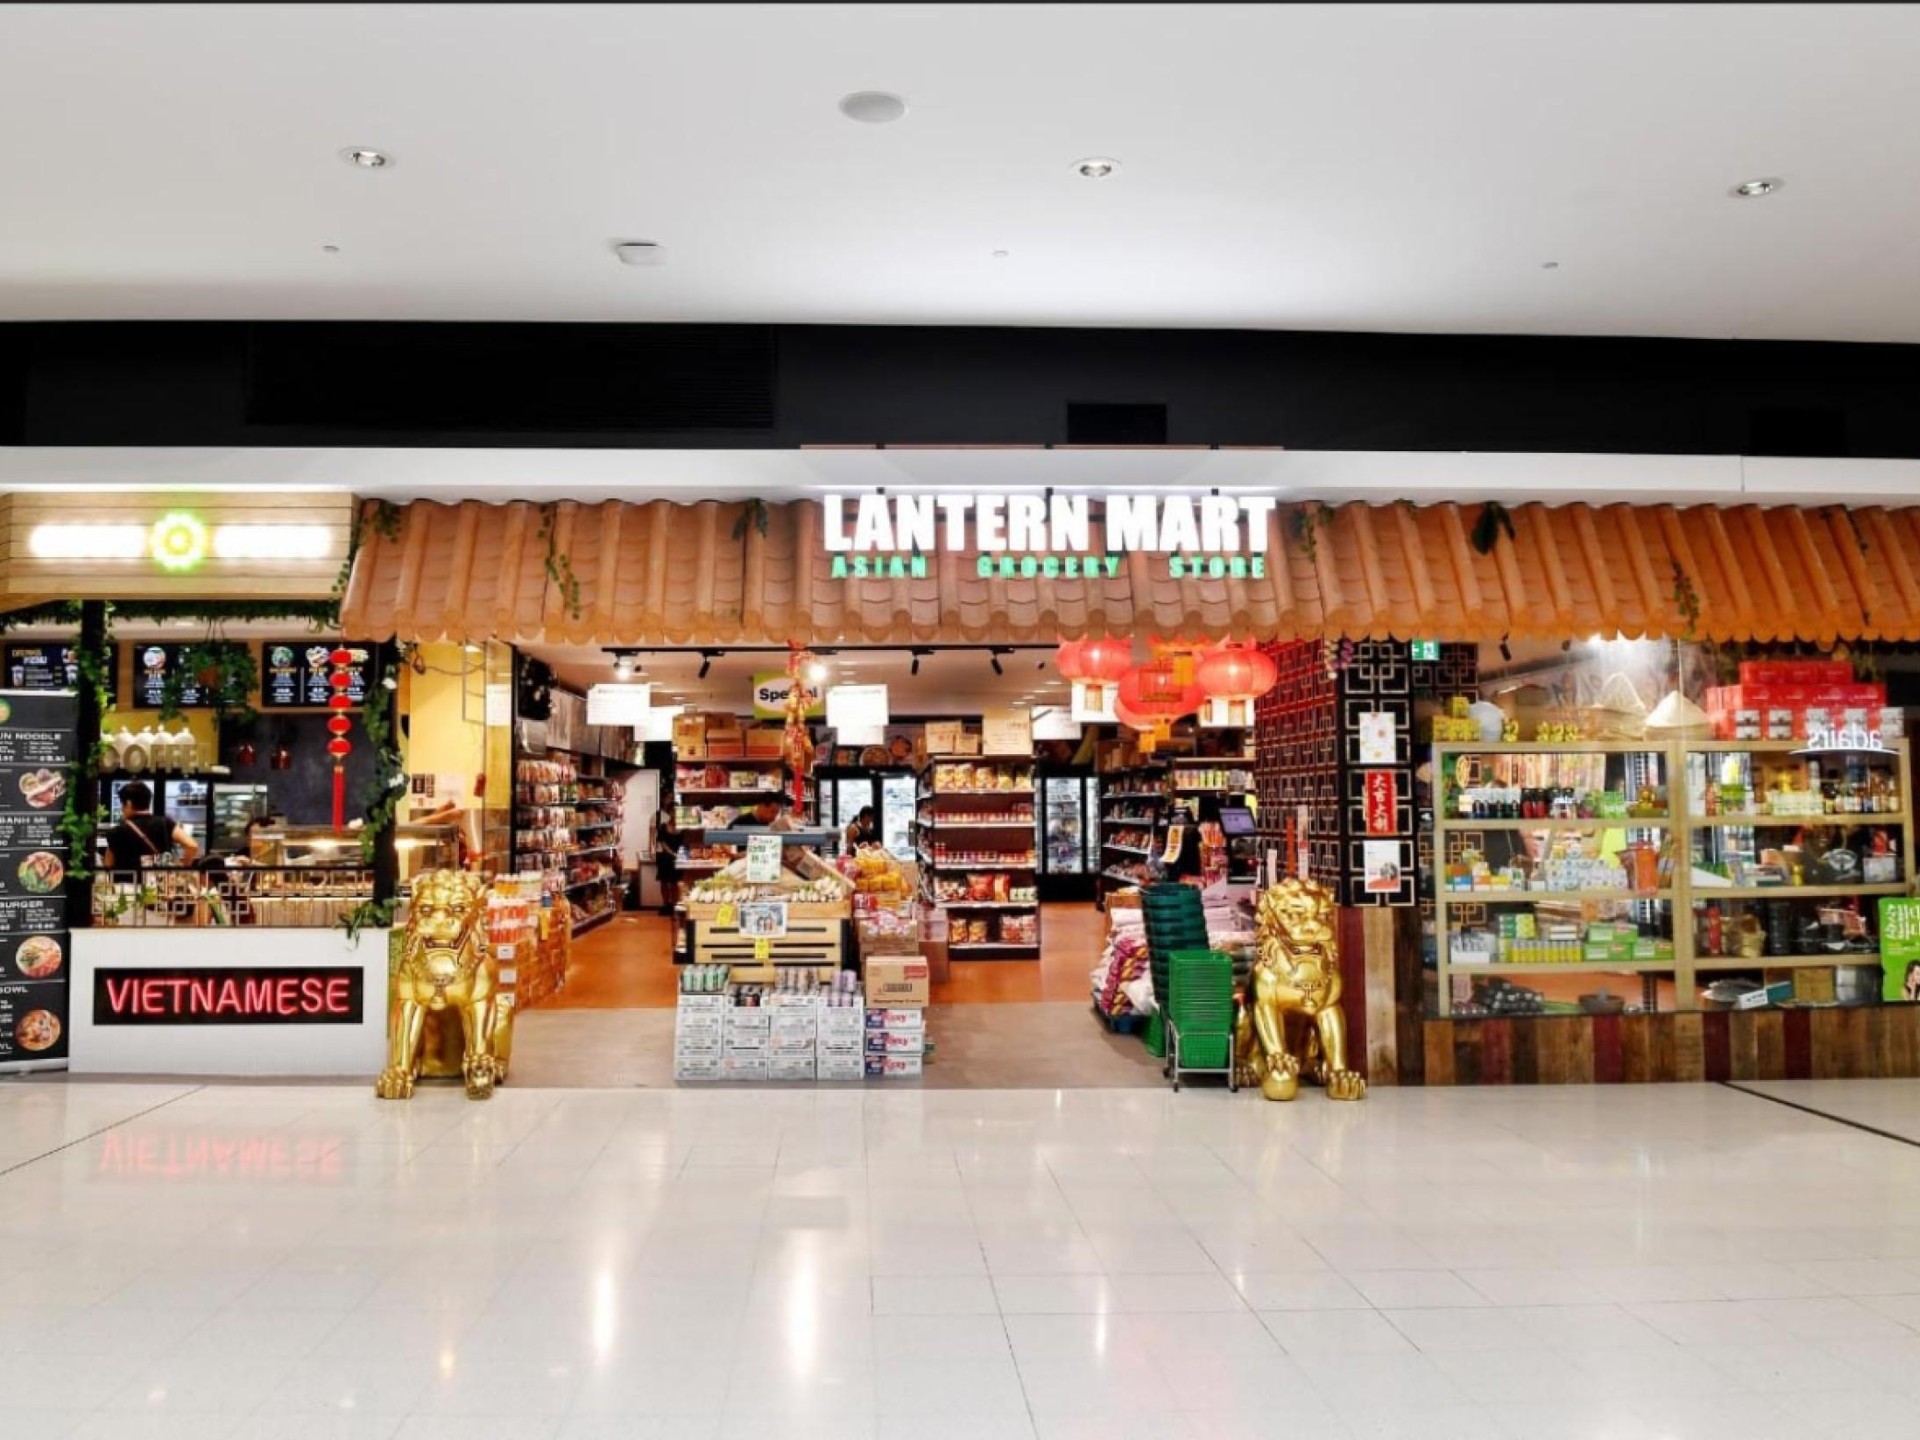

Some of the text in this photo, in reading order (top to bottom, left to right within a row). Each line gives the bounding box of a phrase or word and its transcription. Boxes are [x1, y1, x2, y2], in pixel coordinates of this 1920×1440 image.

[823, 495, 1276, 551] LANTERN MART
[831, 556, 1265, 578] ASIAN GROCERY STORE
[759, 687, 818, 703] Speal
[106, 978, 350, 1015] VIETNAMESE
